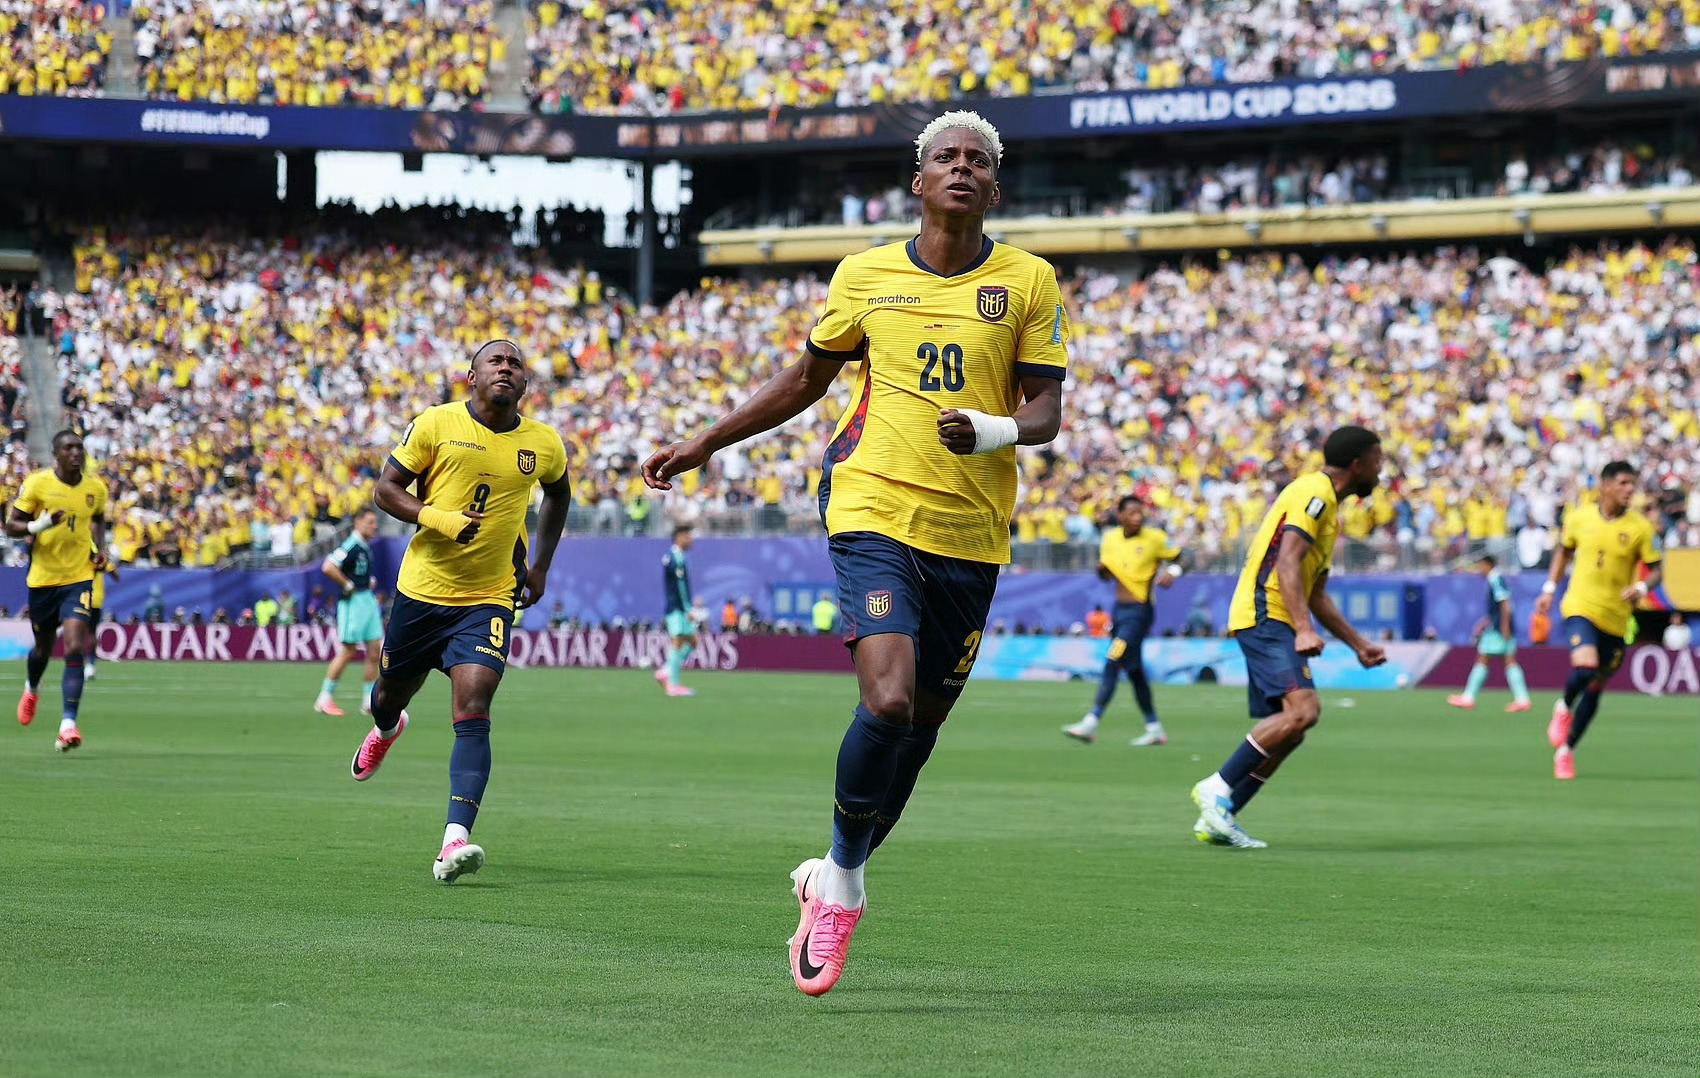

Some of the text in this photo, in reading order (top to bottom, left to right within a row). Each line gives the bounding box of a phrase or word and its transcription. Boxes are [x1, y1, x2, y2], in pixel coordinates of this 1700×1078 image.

[1070, 79, 1397, 129] FIFA WORLD CUP 2026
[867, 294, 921, 306] marathon
[917, 342, 966, 393] 20
[449, 439, 487, 453] marathon
[469, 483, 491, 513] 9
[96, 621, 372, 662] QATAR AIRW
[489, 616, 504, 648] 9
[506, 627, 739, 670] QATAR AIRAYS
[475, 645, 506, 663] maratho
[1630, 641, 1700, 696] QA
